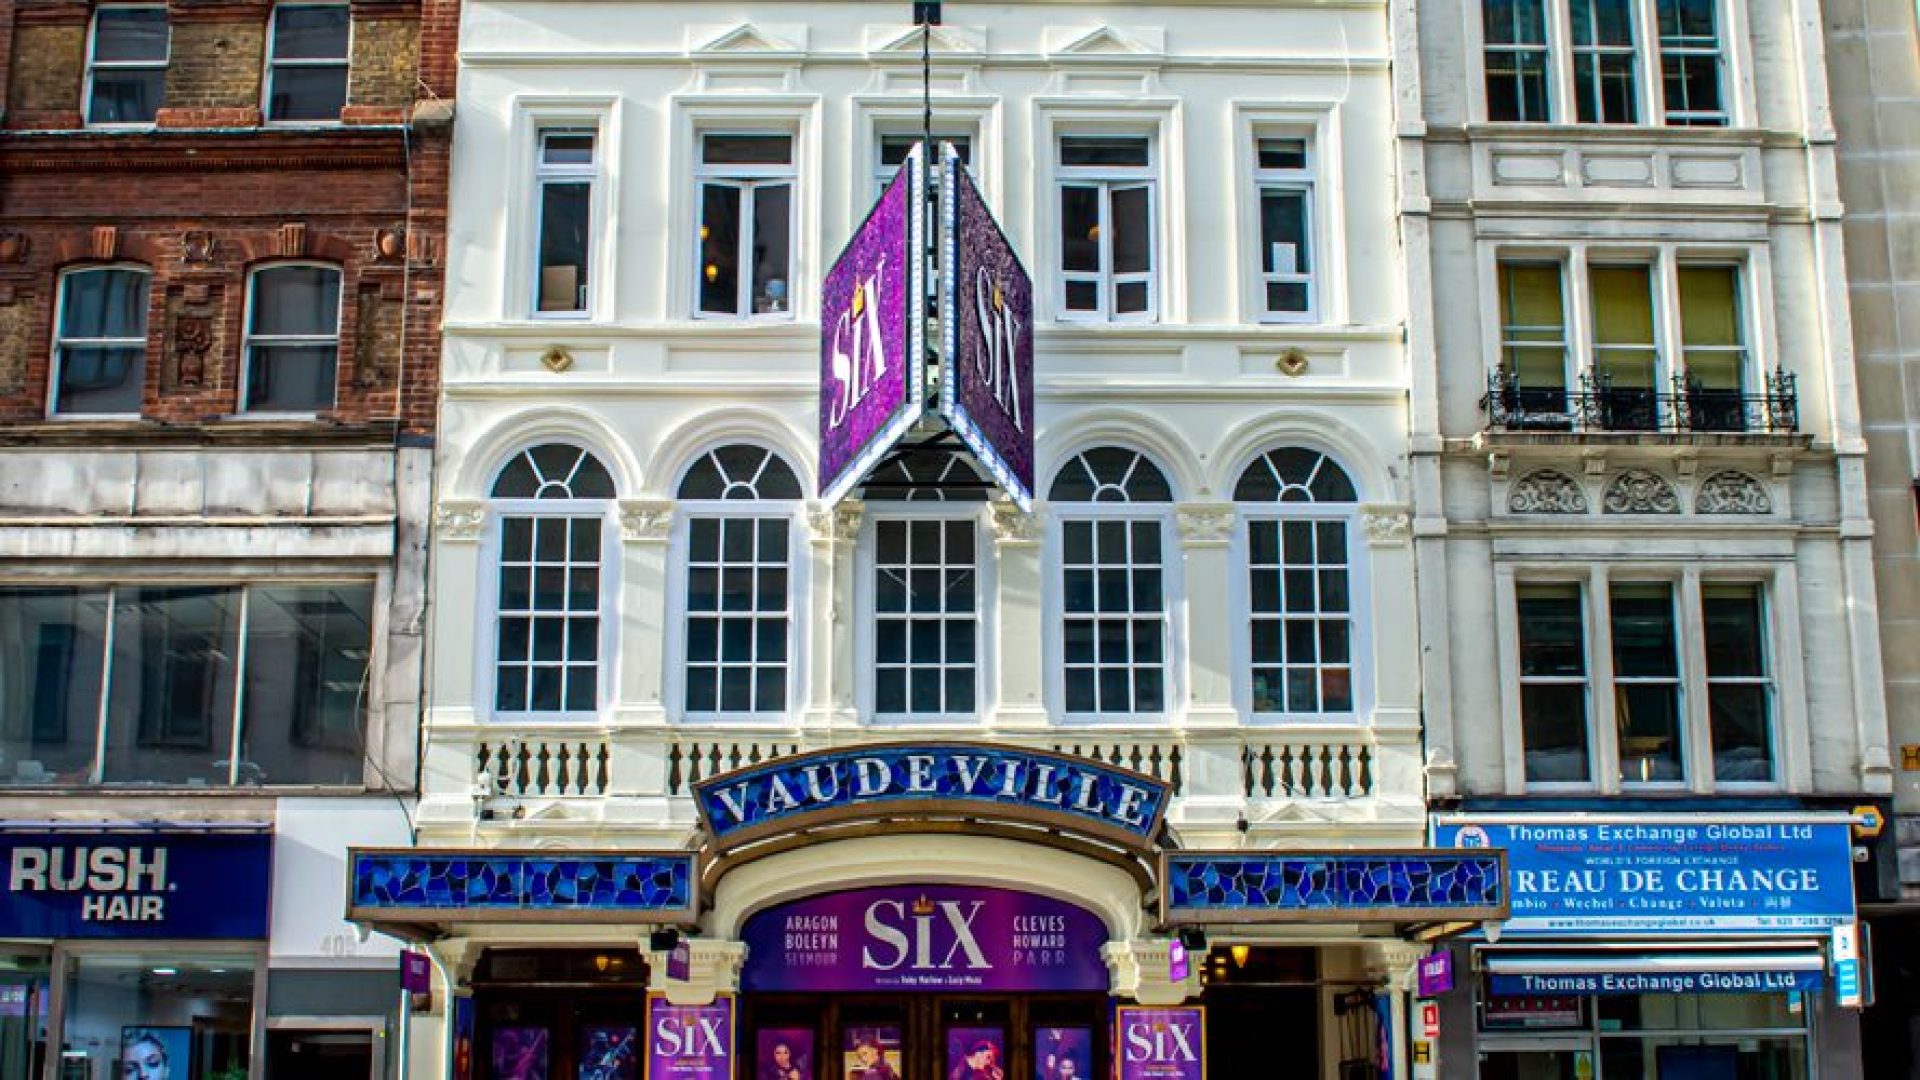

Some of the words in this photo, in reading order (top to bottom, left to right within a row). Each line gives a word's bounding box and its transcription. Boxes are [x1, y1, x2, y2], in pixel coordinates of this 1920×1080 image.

[714, 754, 1150, 827] VAUDEVILLE
[1507, 825, 1588, 841] Thomas
[1598, 825, 1698, 843] Exchange
[1706, 824, 1772, 840] Global
[1781, 824, 1813, 839] Ltd
[1620, 870, 1664, 893] DE
[1676, 869, 1819, 892] CHANGE
[82, 895, 165, 921] HAIR
[1629, 896, 1683, 910] Change
[786, 915, 838, 930] ARAGON
[1013, 915, 1065, 932] CLEVES
[785, 933, 838, 949] BOLEYN
[1013, 935, 1065, 949] HOWARD
[1013, 950, 1065, 966] PARR
[1522, 976, 1597, 990] Thomas
[1603, 975, 1694, 992] Exchange
[1700, 973, 1760, 988] Global
[1766, 972, 1796, 987] Ltd
